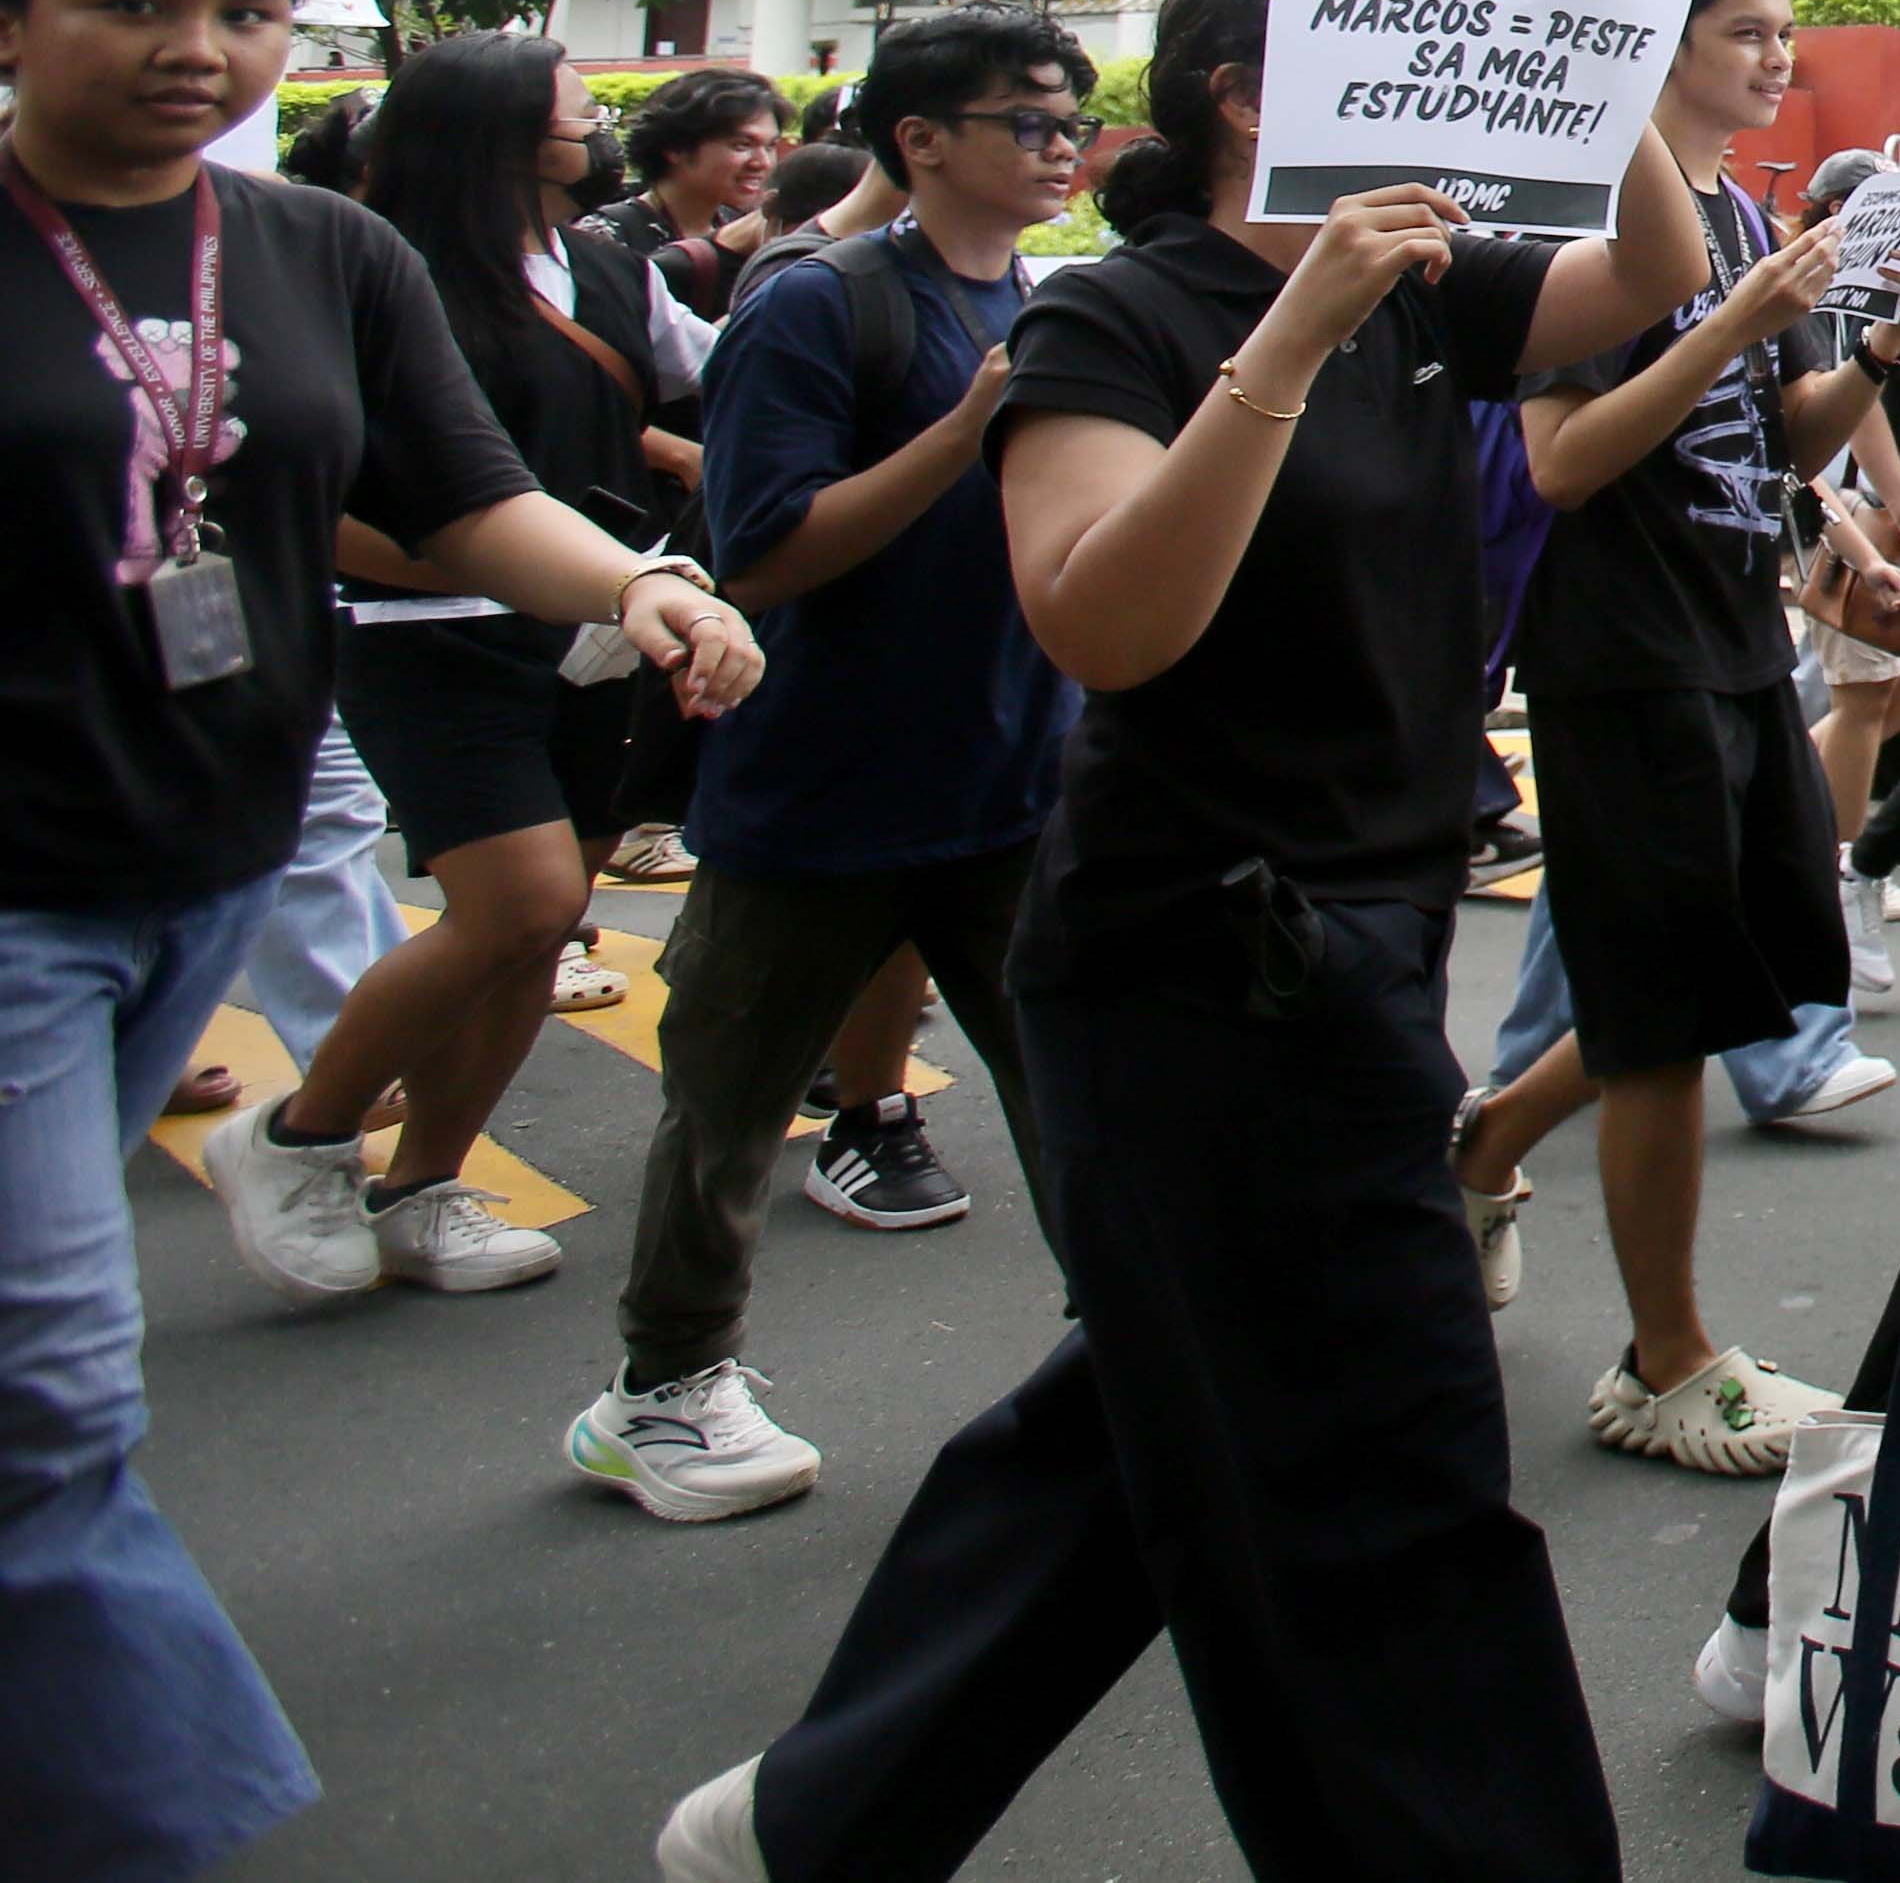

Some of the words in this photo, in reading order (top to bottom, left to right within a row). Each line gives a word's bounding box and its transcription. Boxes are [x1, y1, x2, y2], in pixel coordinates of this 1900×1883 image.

[1509, 13, 1534, 36] =
[1544, 10, 1657, 63] PESTE
[1407, 39, 1468, 79] SA
[1478, 46, 1571, 94] MGA
[1336, 81, 1608, 146] ESTUDYANTE!
[55, 231, 100, 291] SERVICE
[200, 234, 219, 312] PHILIPPINES
[98, 300, 161, 384] EXCELLENCE
[201, 314, 216, 342] THE
[203, 344, 217, 362] OF
[158, 396, 187, 451] HONOR
[193, 367, 217, 449] UNIVERSITY
